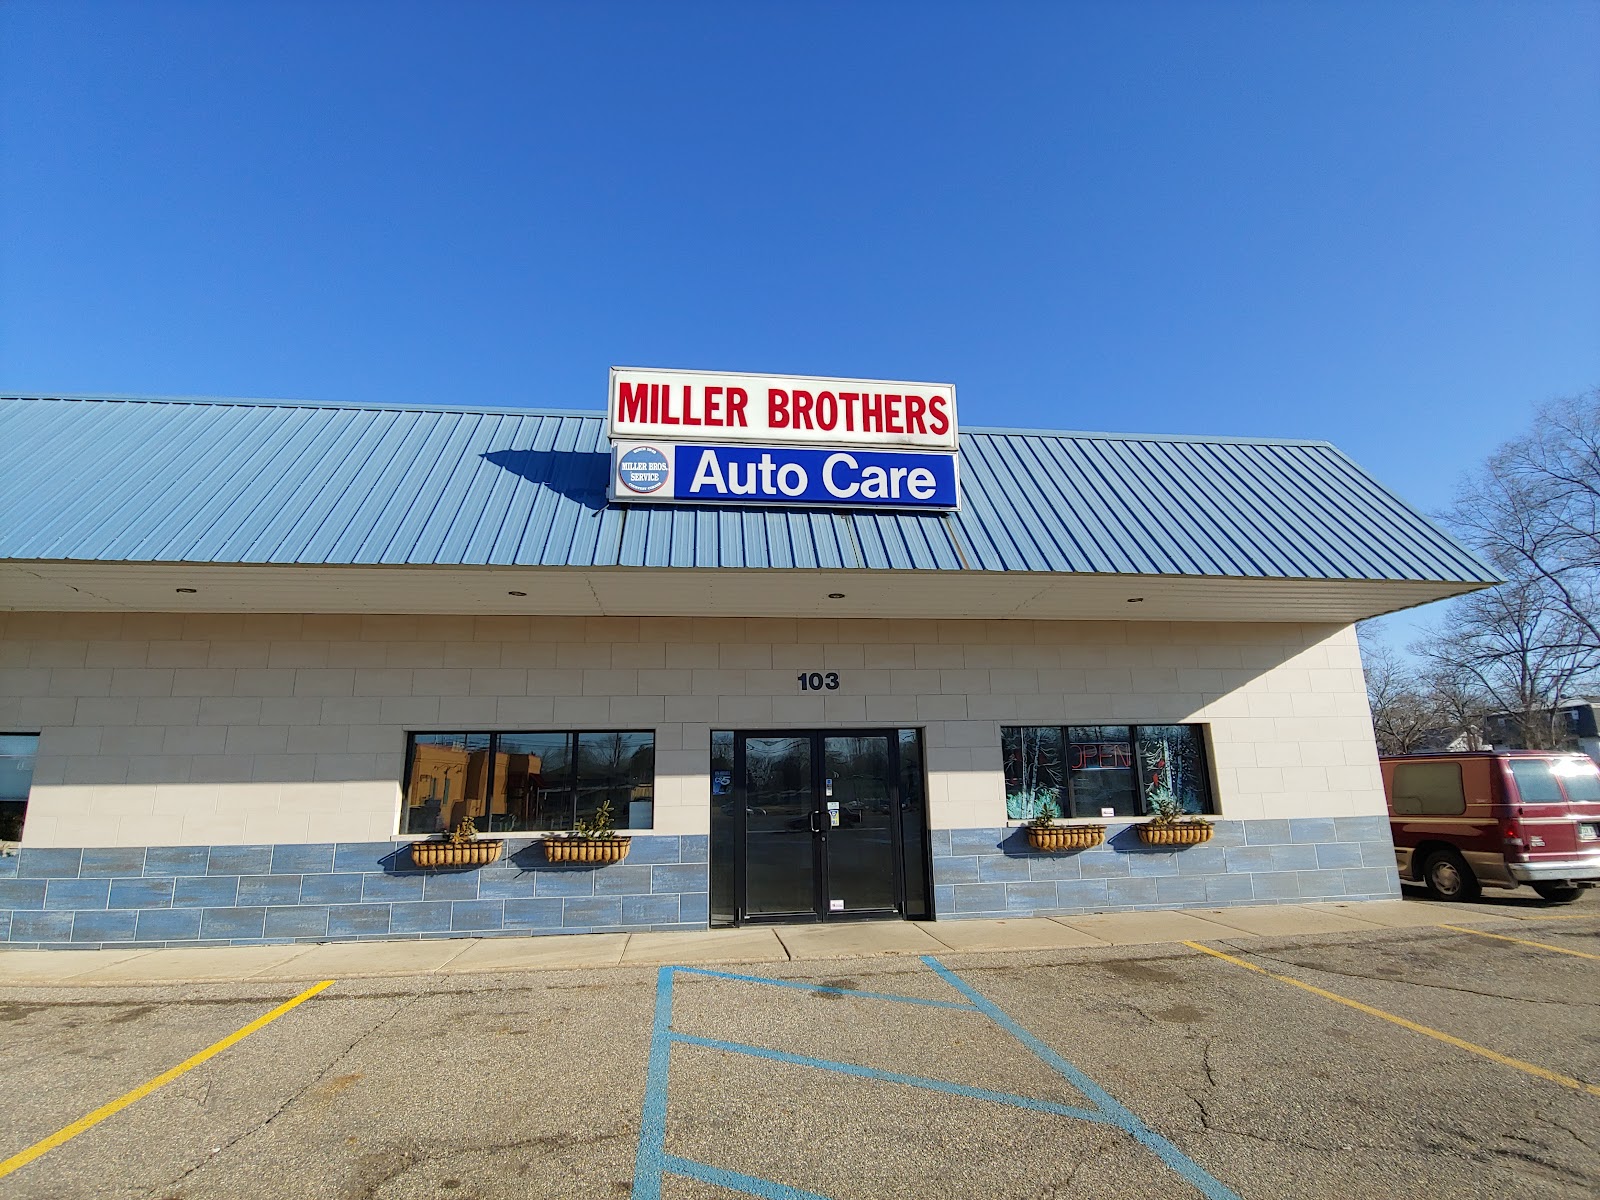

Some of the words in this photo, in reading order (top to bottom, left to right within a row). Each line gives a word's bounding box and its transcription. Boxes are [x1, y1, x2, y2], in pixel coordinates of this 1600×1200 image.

[618, 382, 748, 427] MILLER
[768, 388, 949, 436] BROTHERS
[621, 462, 647, 471] MILLER
[689, 449, 808, 497] Auto
[822, 453, 937, 500] Care
[630, 472, 660, 482] SERVICE
[797, 672, 840, 691] 103
